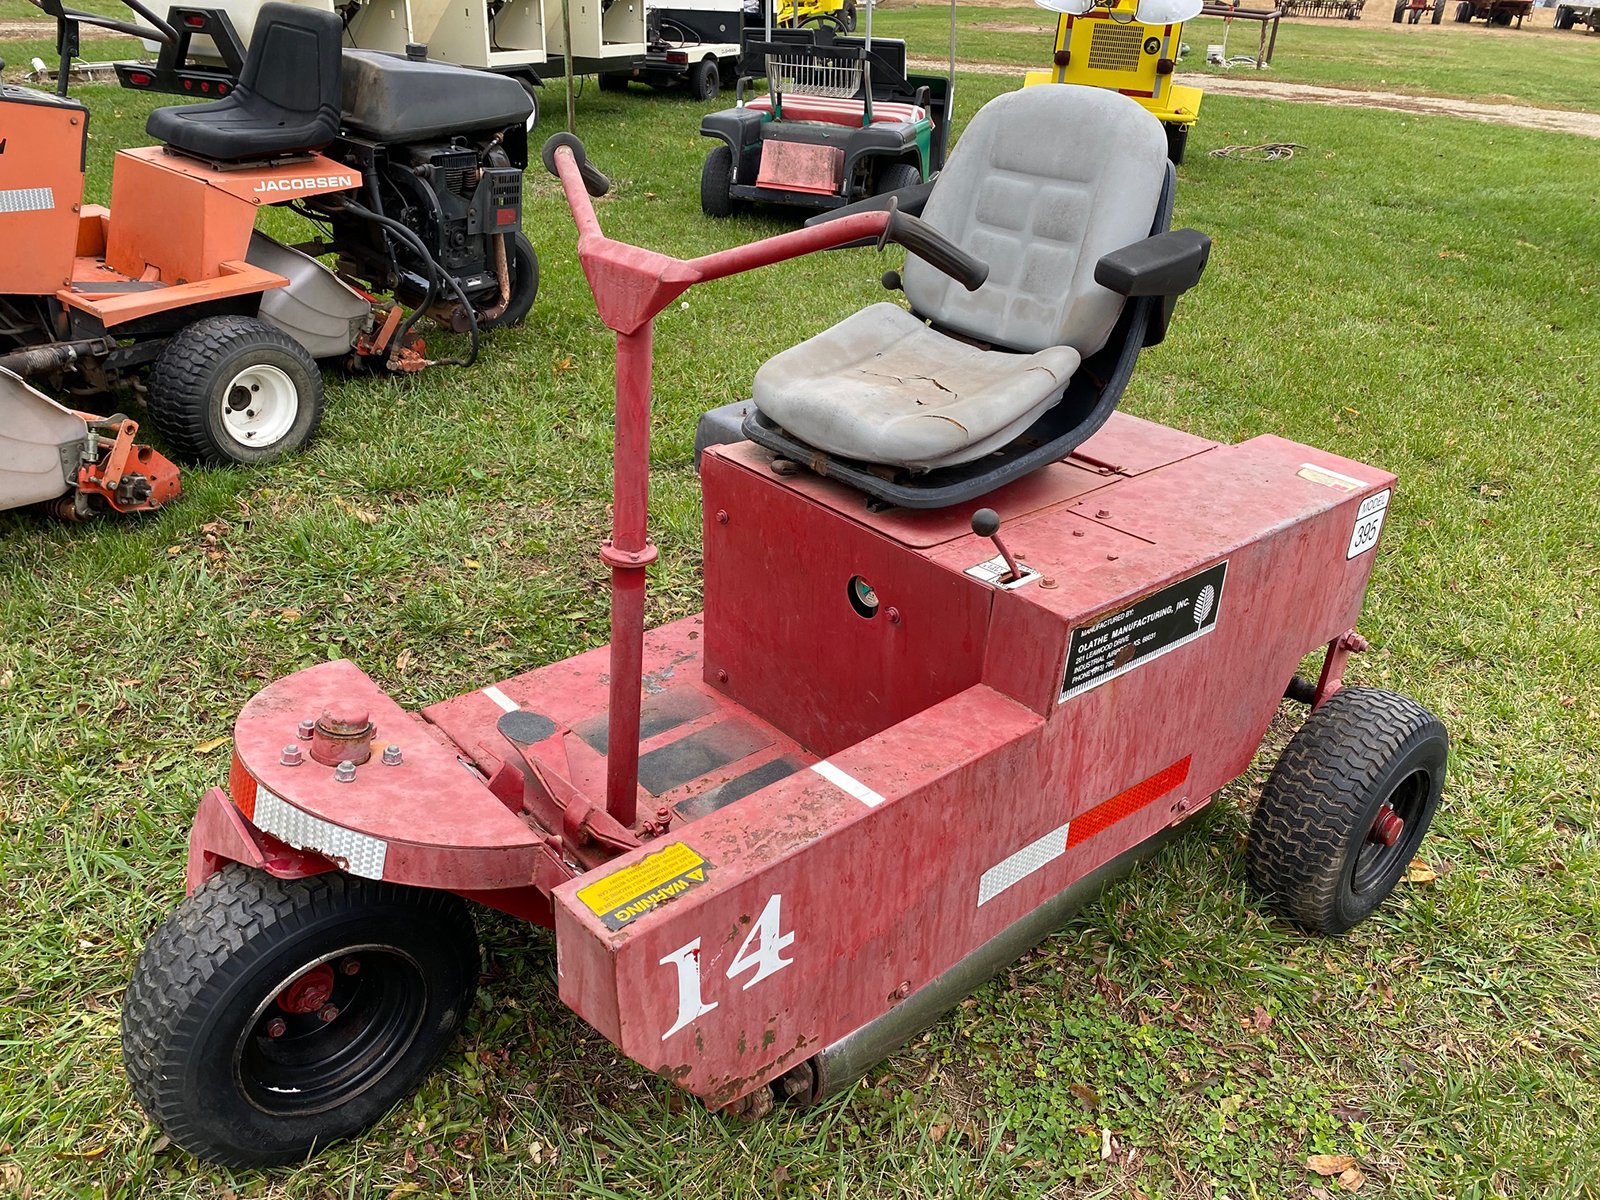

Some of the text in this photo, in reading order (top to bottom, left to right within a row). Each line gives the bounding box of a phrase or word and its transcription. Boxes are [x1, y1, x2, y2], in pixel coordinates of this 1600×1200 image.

[253, 176, 352, 192] JACOBSEN
[1362, 496, 1384, 513] MODEL
[1355, 519, 1378, 547] 395
[1078, 633, 1109, 653] OLATHE
[1111, 605, 1174, 639] MANUFACTURING,
[1081, 612, 1125, 637] MANUFACTURED
[1086, 642, 1113, 660] LEAWOOD
[1113, 634, 1130, 648] DRIVE
[1073, 654, 1105, 674] INDUSTRIAL
[614, 879, 690, 921] WARNING
[659, 894, 795, 1041] 14
